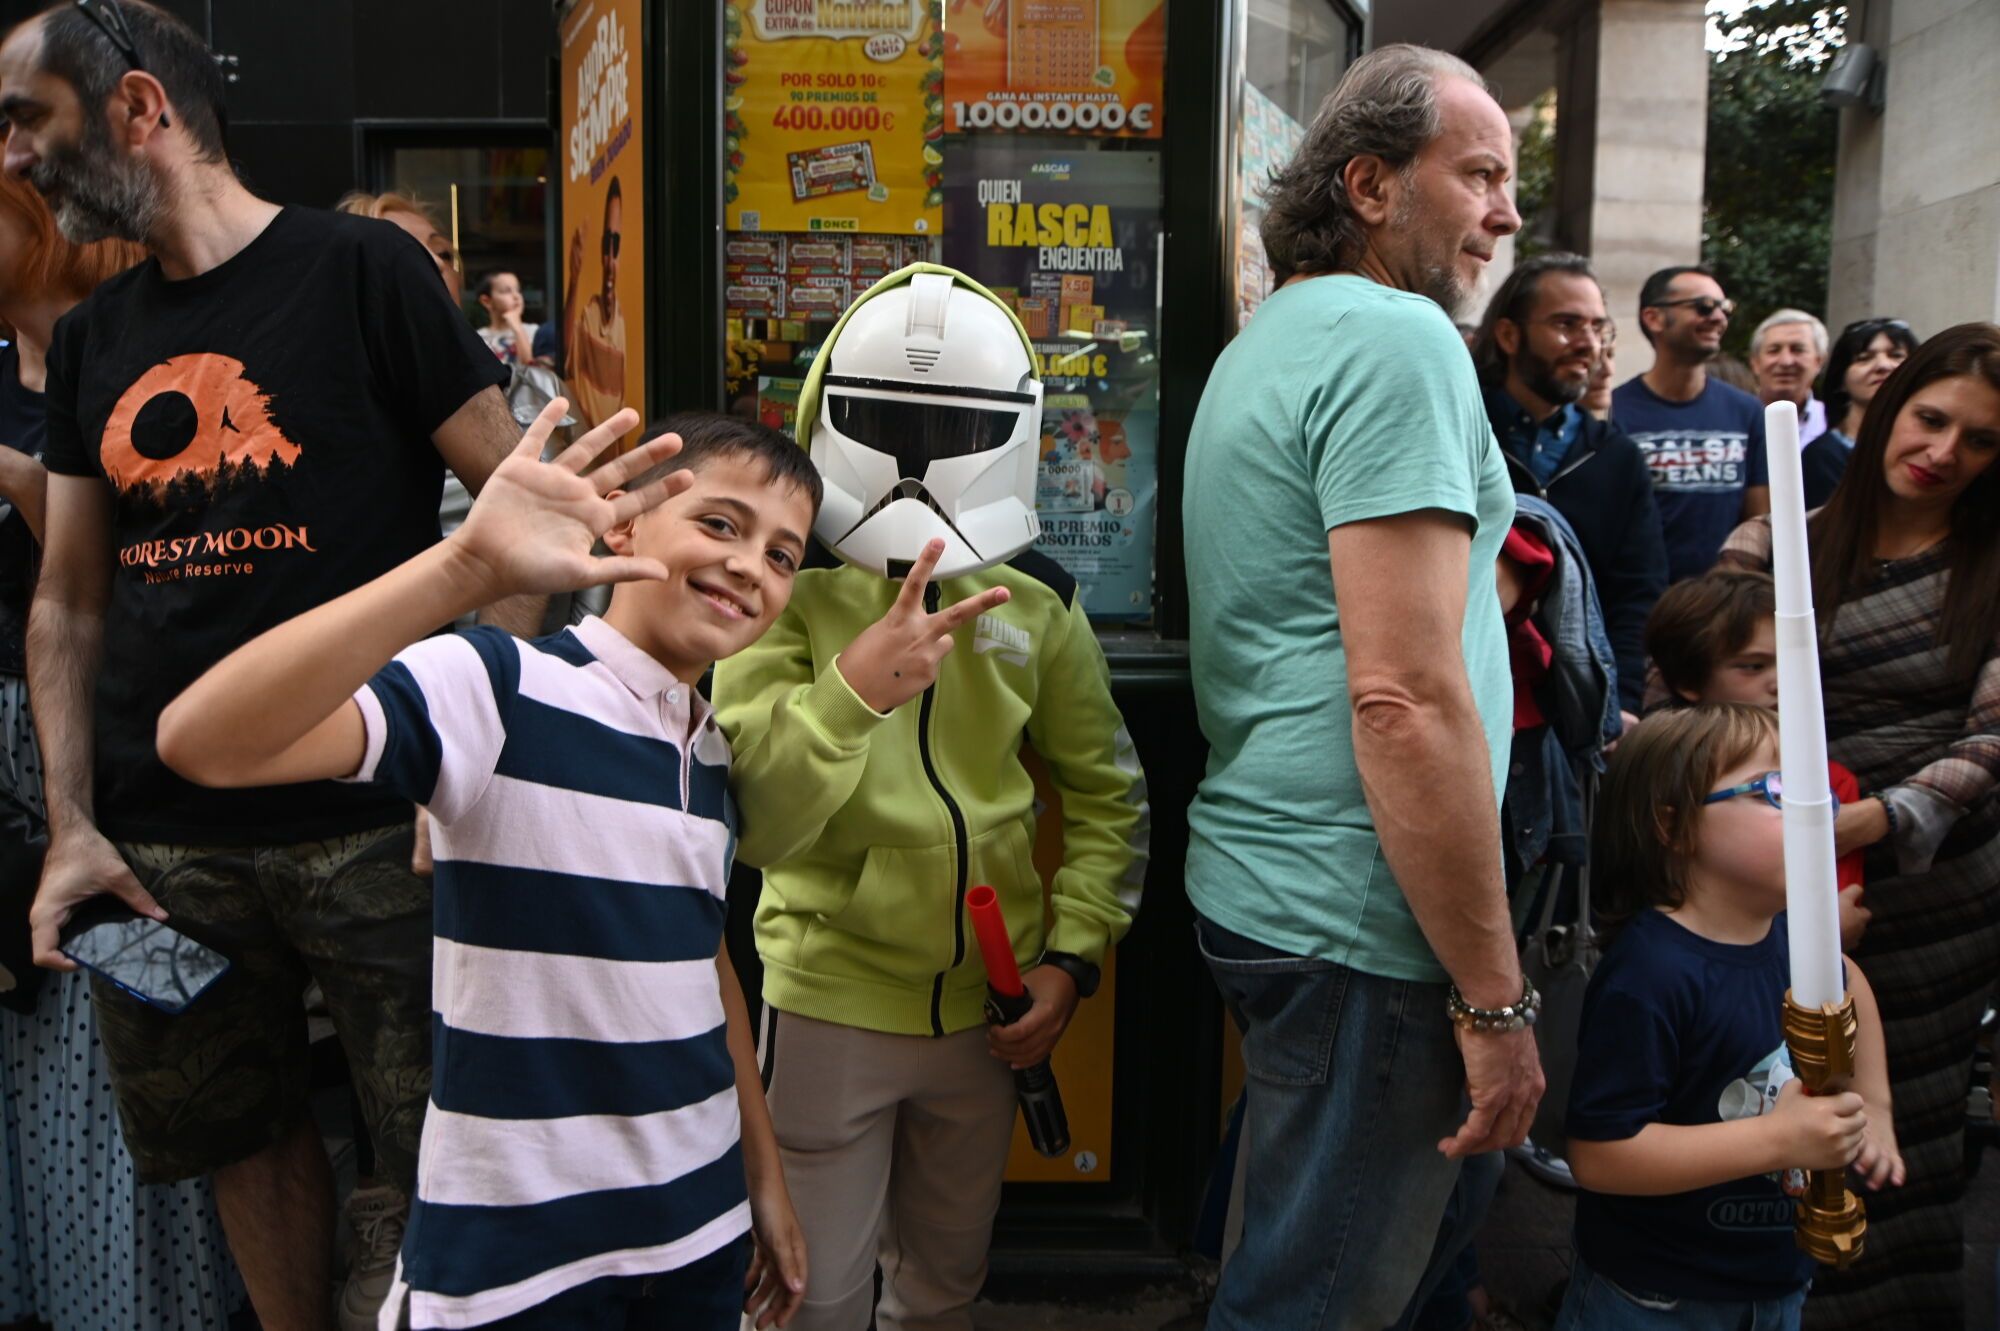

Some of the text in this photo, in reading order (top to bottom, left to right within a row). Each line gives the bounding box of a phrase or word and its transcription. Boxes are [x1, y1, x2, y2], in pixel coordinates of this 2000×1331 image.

[765, 17, 799, 30] EXTRA
[817, 0, 909, 30] Navidad
[781, 73, 812, 88] POR
[817, 73, 856, 88] SOLO
[806, 92, 859, 102] PREMIOS
[863, 92, 878, 102] DE
[987, 92, 1121, 102] GANA AL INSTANTE HASTA
[570, 50, 629, 183] SIEMPRE
[978, 179, 1022, 208] QUIEN
[823, 220, 856, 230] ONCE
[987, 203, 1114, 248] RASCA
[1039, 247, 1124, 272] ENCUENTRA
[1058, 520, 1121, 534] PREMIO
[120, 523, 318, 568] FOREST MOON
[1036, 533, 1112, 547] OSOTROS
[144, 562, 254, 585] Nature Reserve
[977, 615, 1030, 651] PUMA
[1719, 1199, 1795, 1224] OCTO
